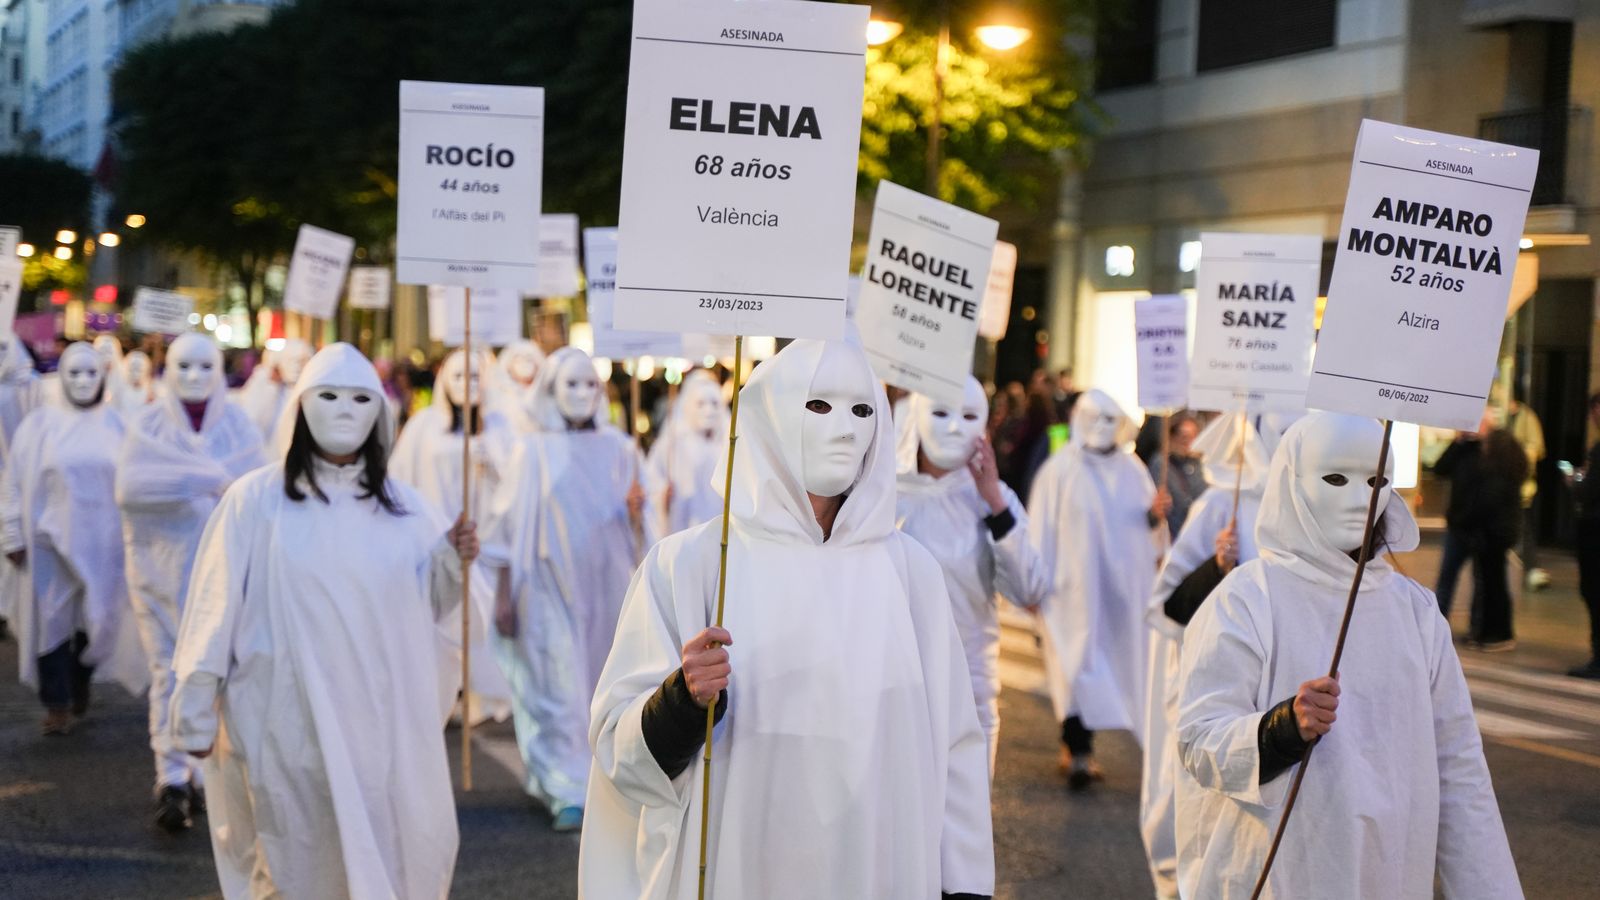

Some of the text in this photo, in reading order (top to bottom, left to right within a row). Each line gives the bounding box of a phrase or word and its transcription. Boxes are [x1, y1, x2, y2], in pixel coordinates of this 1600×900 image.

[720, 28, 784, 42] ASESINADA
[669, 96, 822, 140] ELENA
[426, 143, 515, 169] ROCÍO
[694, 154, 792, 181] 68 años
[1425, 159, 1474, 176] ASESINADA
[439, 178, 500, 195] 44 años
[696, 205, 779, 228] València
[1371, 196, 1493, 237] AMPARO
[1347, 227, 1502, 276] MONTALVÀ
[880, 238, 974, 290] RAQUEL
[1390, 264, 1465, 293] 52 años
[868, 264, 977, 321] LORENTE
[1218, 280, 1295, 303] MARÍA
[698, 297, 763, 312] 23/03/2023
[909, 313, 941, 333] años
[1222, 310, 1287, 329] SANZ
[1397, 310, 1440, 331] Alzira
[1244, 338, 1279, 352] años
[1378, 388, 1429, 404] 08/06/2022
